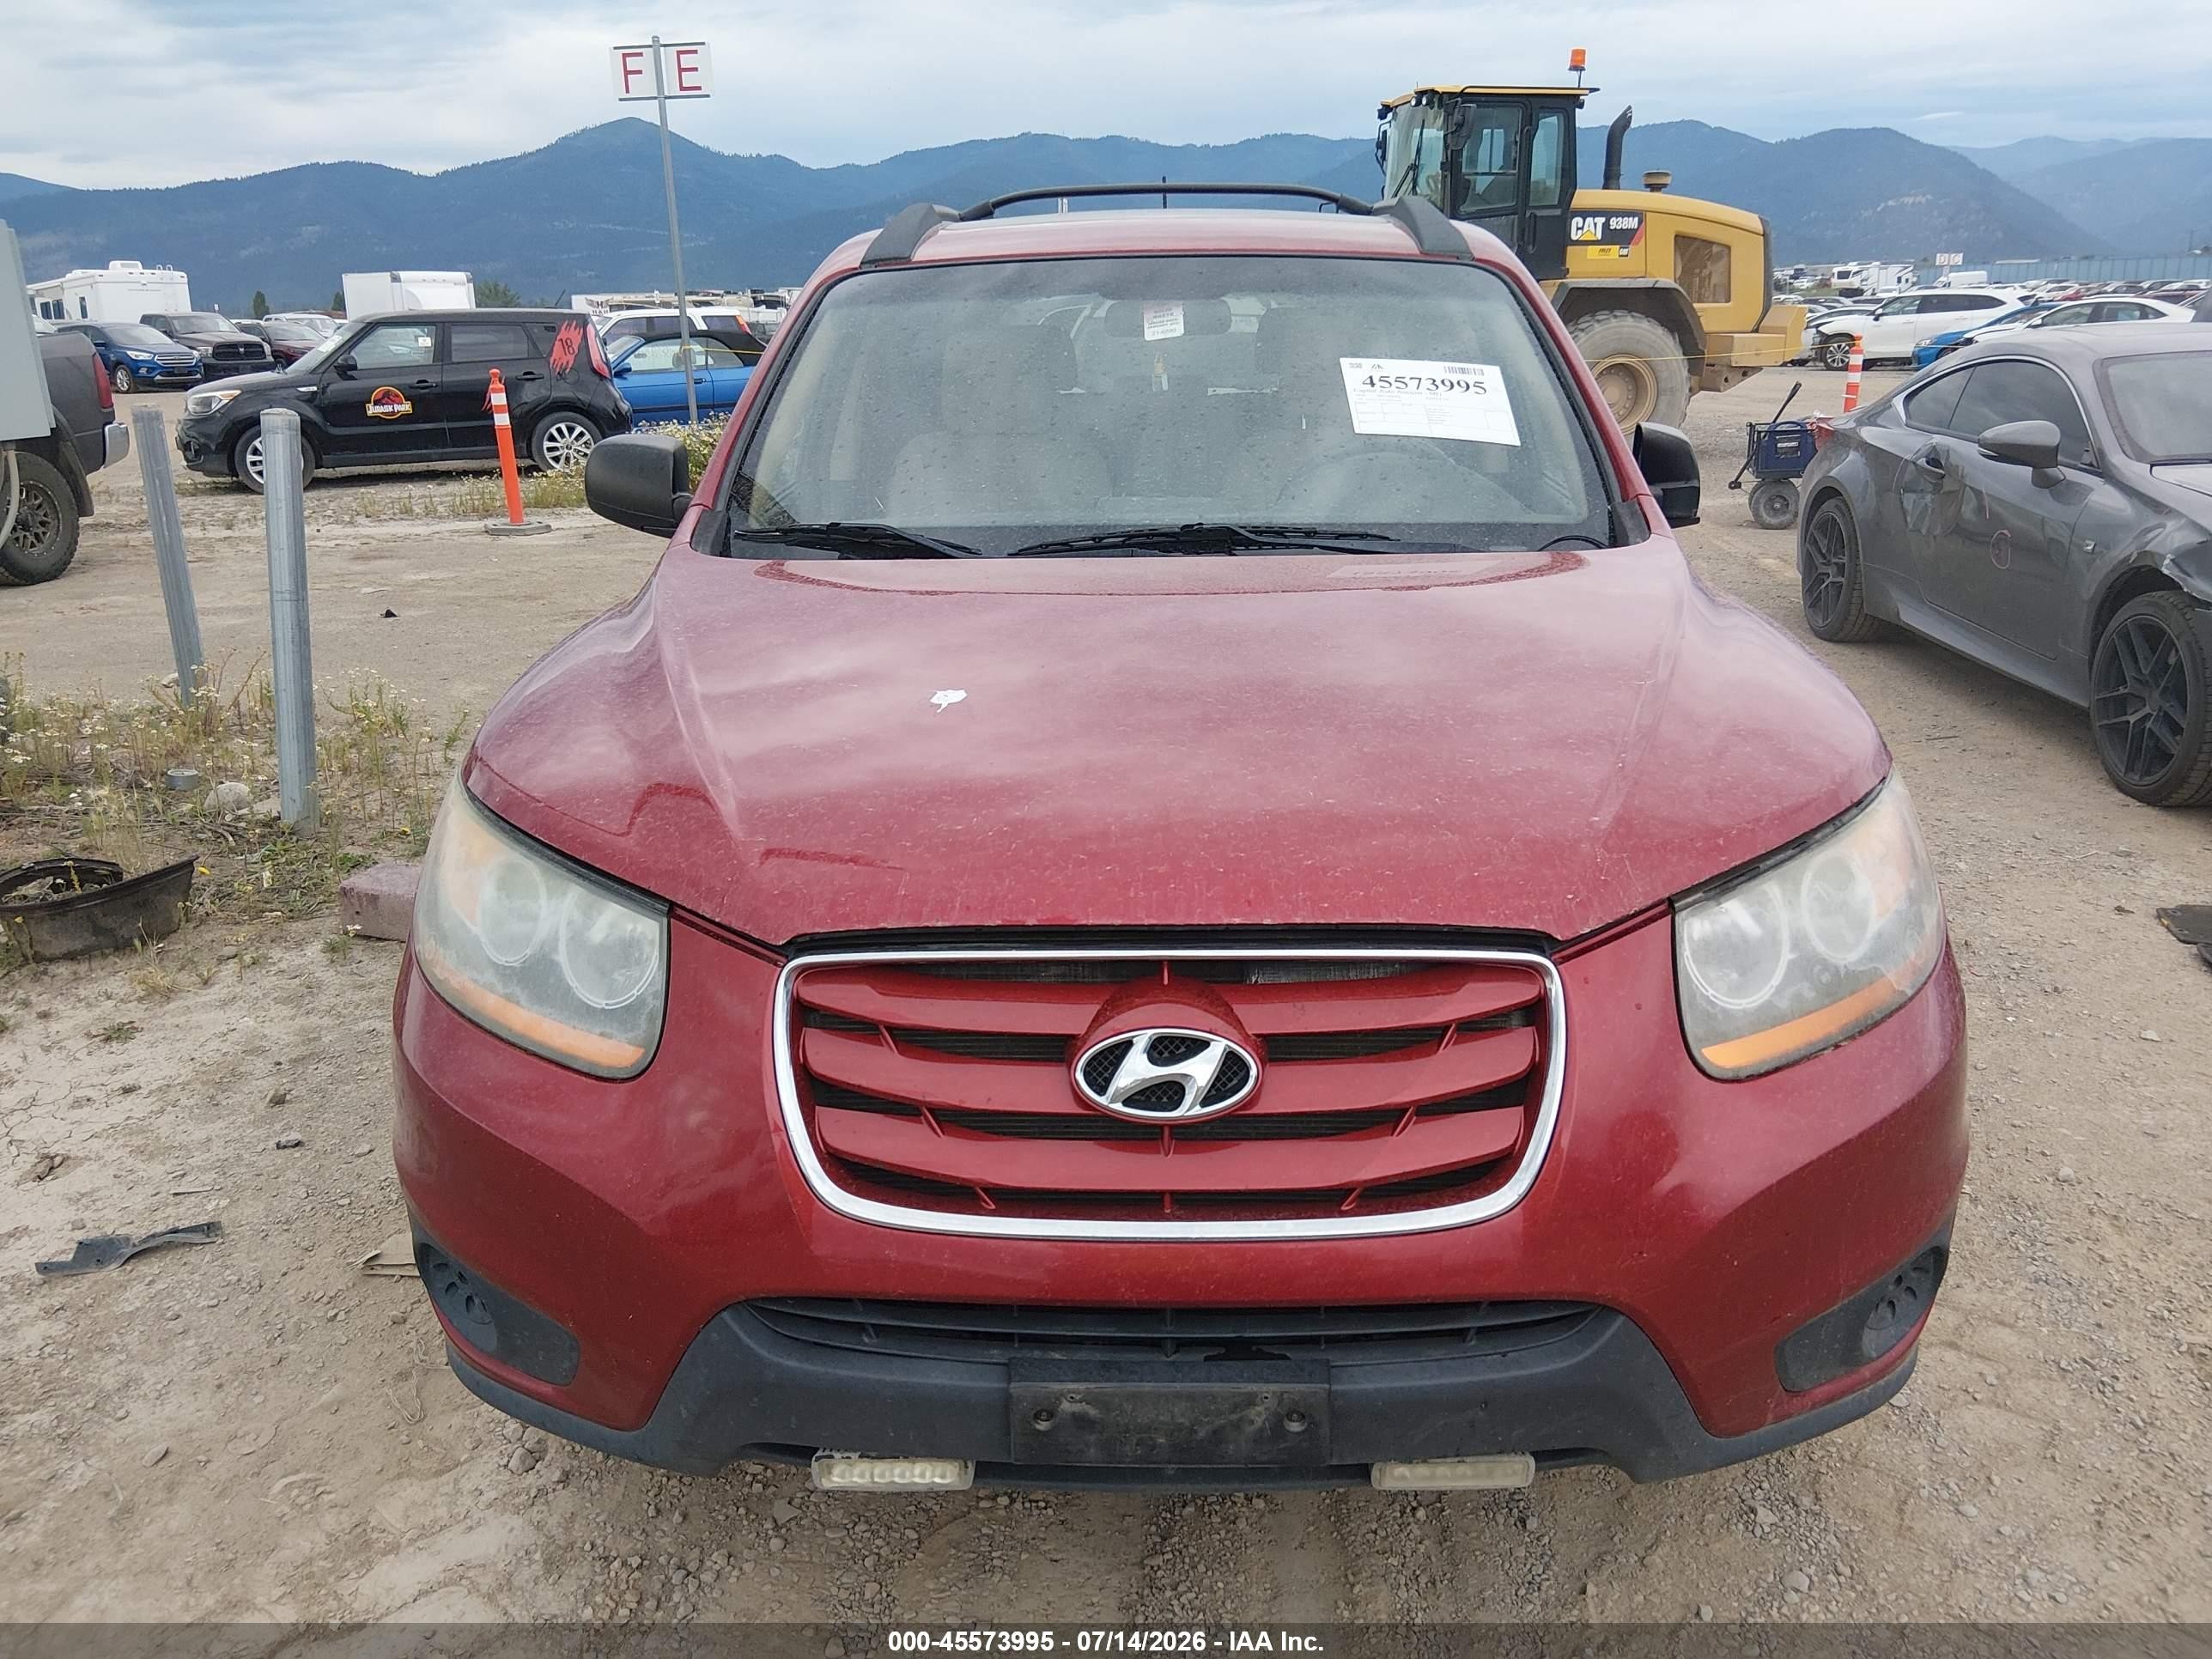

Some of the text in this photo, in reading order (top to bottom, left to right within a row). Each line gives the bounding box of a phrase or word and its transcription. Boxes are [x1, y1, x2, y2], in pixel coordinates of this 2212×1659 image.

[621, 52, 644, 94] F
[676, 49, 702, 92] E
[1571, 216, 1638, 240] CAT 938M
[558, 337, 575, 356] 18
[1362, 374, 1487, 395] 45573995
